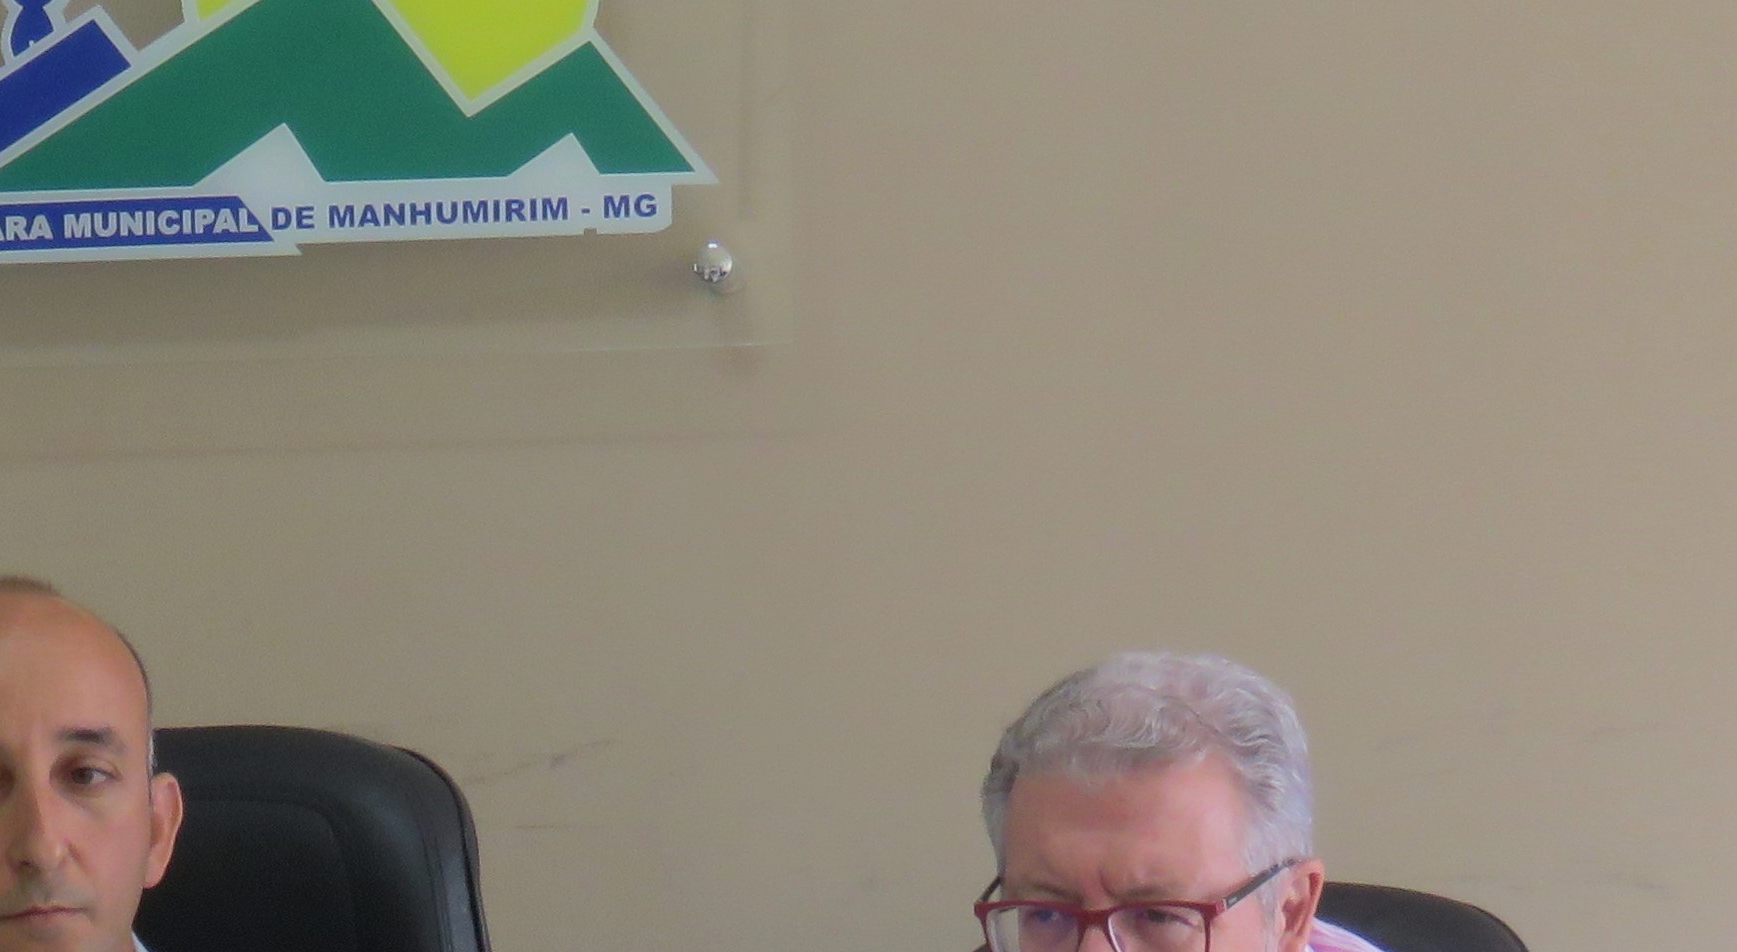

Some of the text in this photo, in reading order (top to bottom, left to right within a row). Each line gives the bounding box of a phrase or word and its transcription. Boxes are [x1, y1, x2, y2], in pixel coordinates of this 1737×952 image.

[63, 207, 259, 239] MUNICIPAL
[271, 206, 315, 230] DE
[328, 197, 569, 229] MANHUMIRIM
[603, 194, 658, 219] MG
